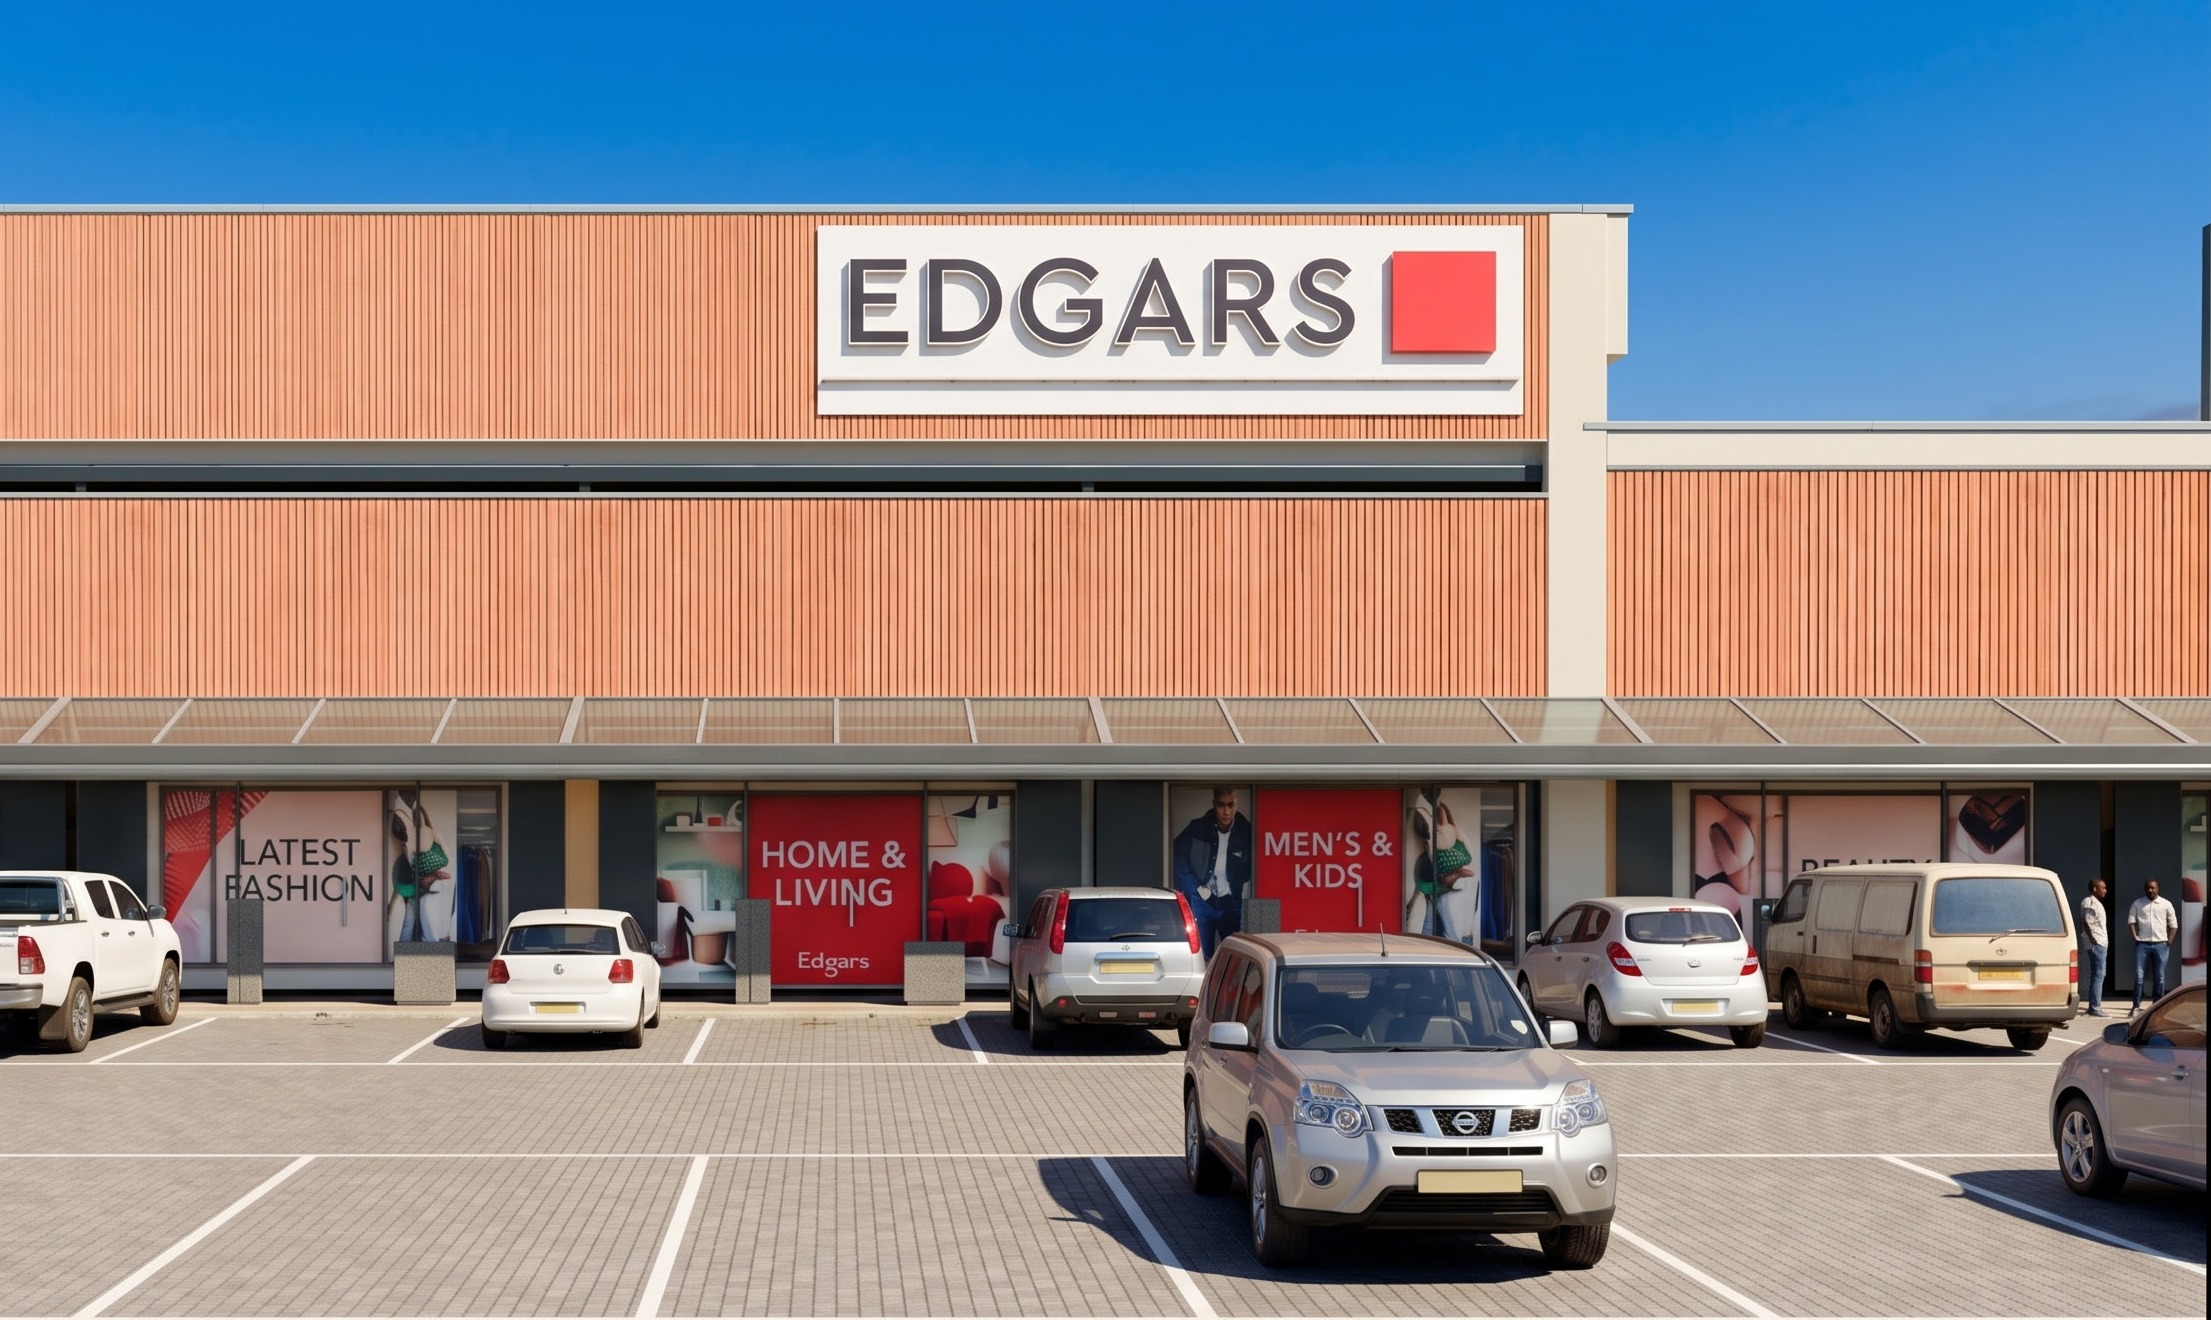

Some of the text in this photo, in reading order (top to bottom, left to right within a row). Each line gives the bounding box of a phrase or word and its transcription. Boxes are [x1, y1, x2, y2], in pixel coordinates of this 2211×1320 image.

[847, 257, 1356, 348] EDGARS
[240, 838, 361, 866] LATEST
[762, 840, 906, 869] HOME &
[1264, 831, 1394, 857] MEN'S &
[225, 874, 374, 902] FASHION
[1294, 863, 1363, 889] KIDS
[775, 878, 893, 907] LIVING
[798, 952, 870, 978] Edgars
